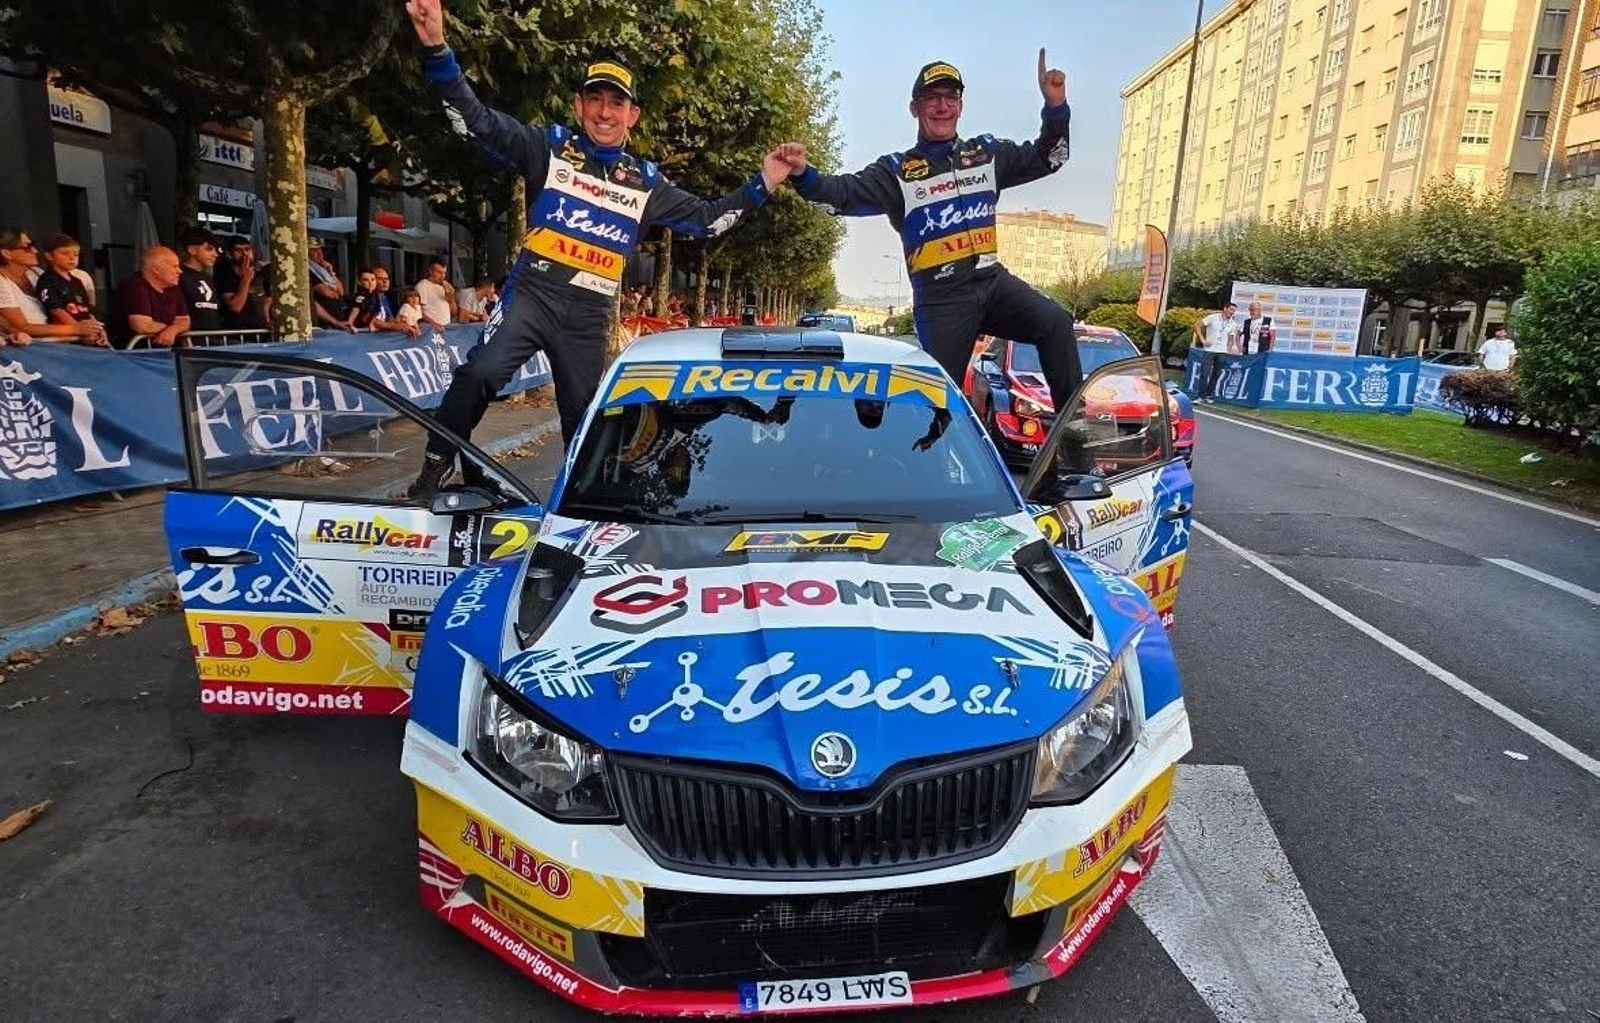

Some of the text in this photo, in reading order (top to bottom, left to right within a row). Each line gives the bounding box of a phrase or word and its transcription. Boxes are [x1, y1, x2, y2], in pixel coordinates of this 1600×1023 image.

[207, 185, 229, 203] Café
[552, 238, 614, 269] ALBO
[682, 364, 878, 395] Recalvi
[1086, 498, 1143, 526] Rallycar
[316, 518, 439, 549] Rallycar
[490, 520, 529, 560] 2
[358, 566, 456, 587] TORREIR
[361, 583, 398, 595] AUTO
[701, 579, 1035, 616] PROMEGA
[216, 664, 250, 678] 1869
[722, 651, 1018, 724] tesis S.L.
[1073, 791, 1149, 879] ALBO
[461, 814, 572, 900] ALBO
[1058, 879, 1126, 963] www.rodavigo.net
[471, 912, 580, 995] www.rodavigo.net
[745, 976, 908, 1008] E 7849 LWS
